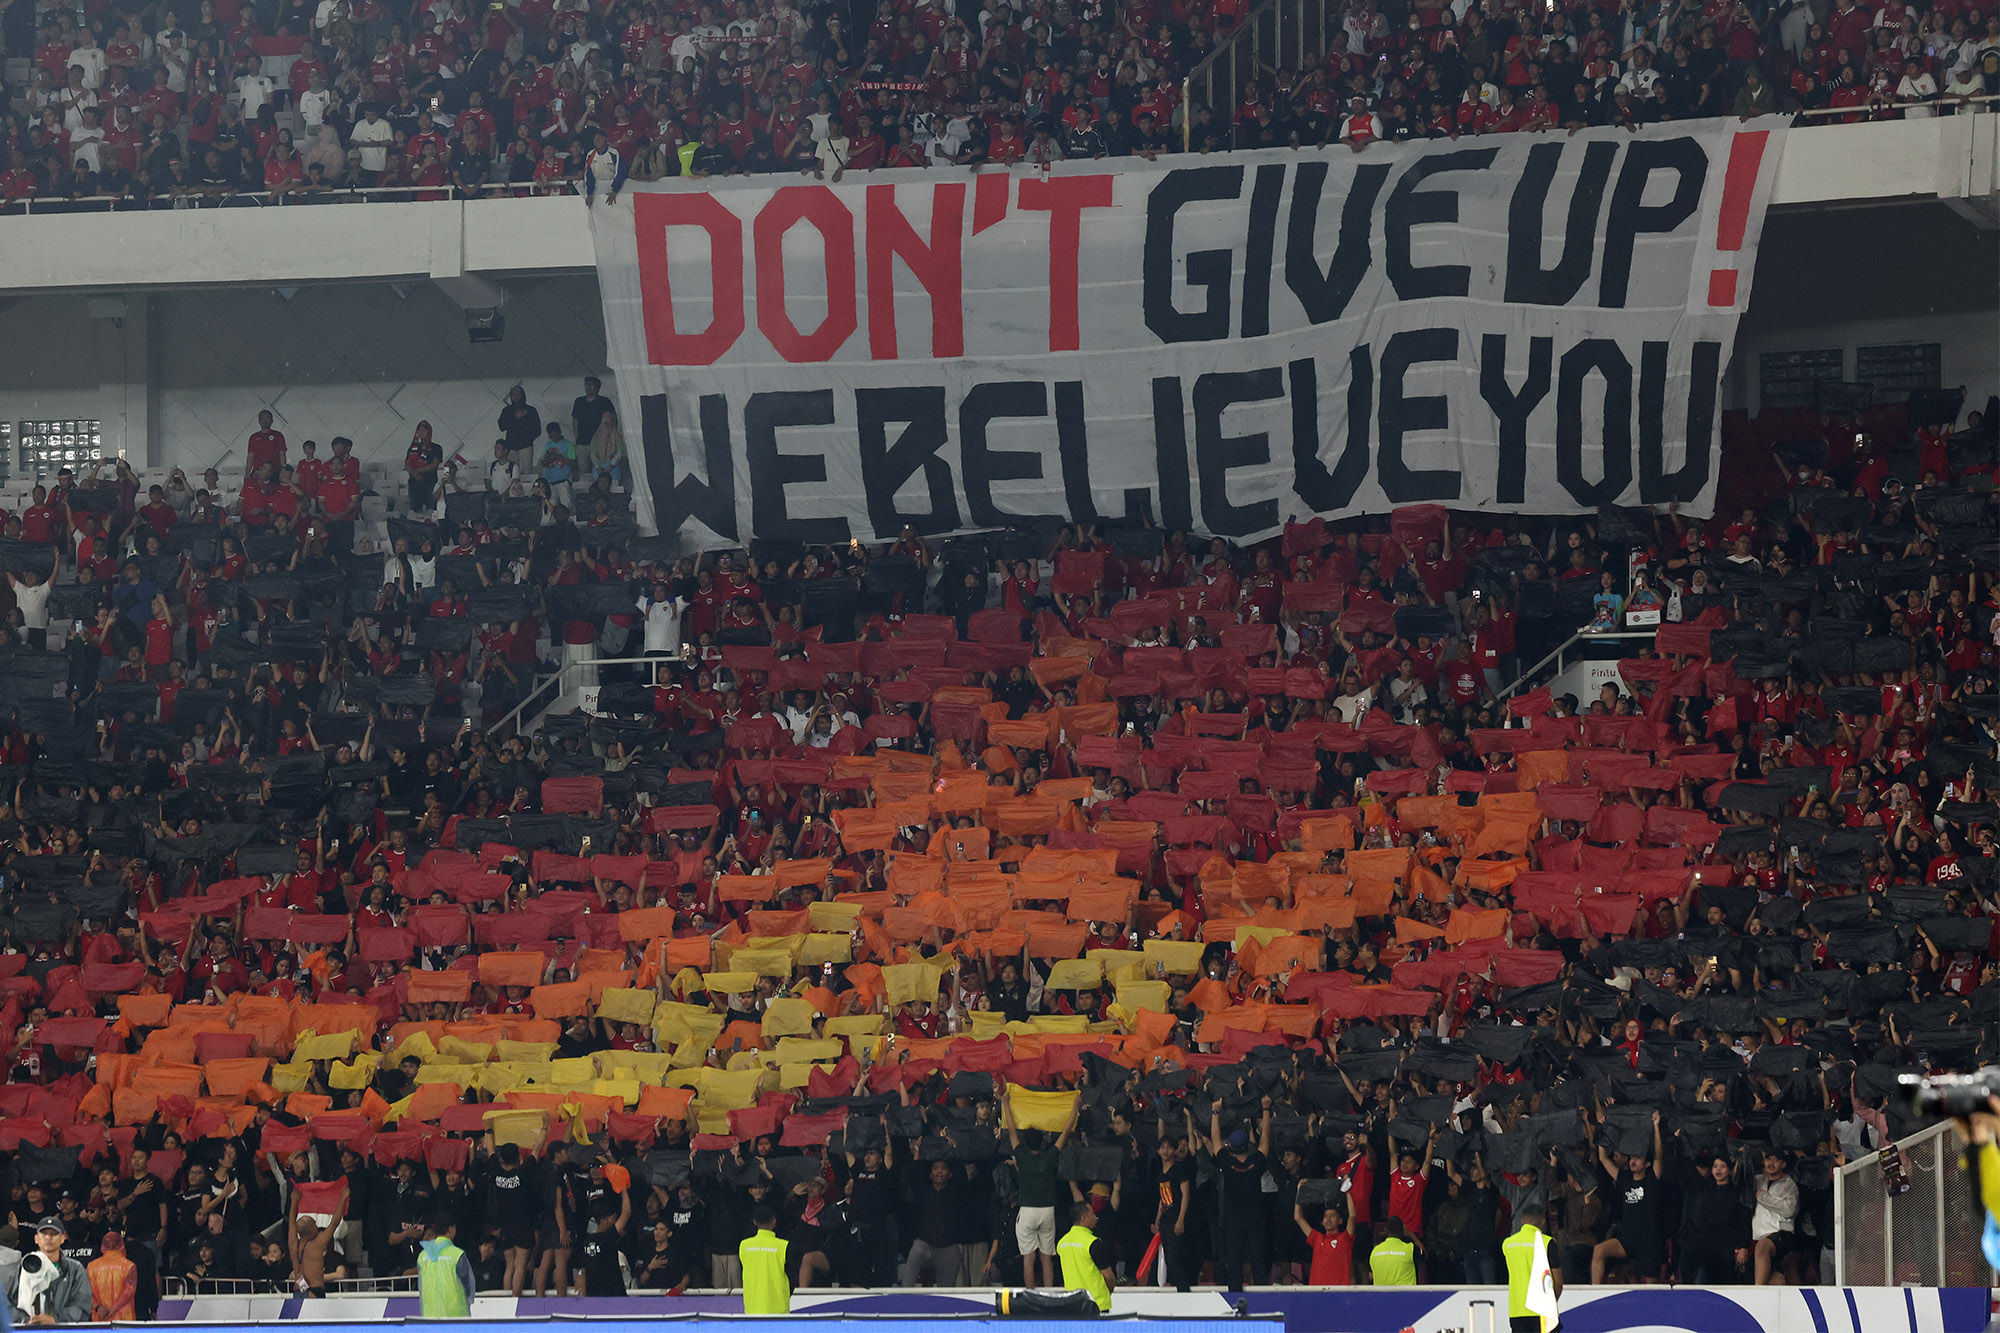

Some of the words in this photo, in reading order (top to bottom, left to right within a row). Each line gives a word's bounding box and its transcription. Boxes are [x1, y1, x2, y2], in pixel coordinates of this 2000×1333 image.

[633, 173, 1113, 366] DON'T
[1143, 147, 1500, 343] GIVE
[1503, 130, 1771, 308] UP!
[640, 389, 852, 543] WE
[854, 327, 1462, 538] BELIEVE
[1480, 333, 1721, 506] YOU
[1591, 669, 1616, 677] Pintu
